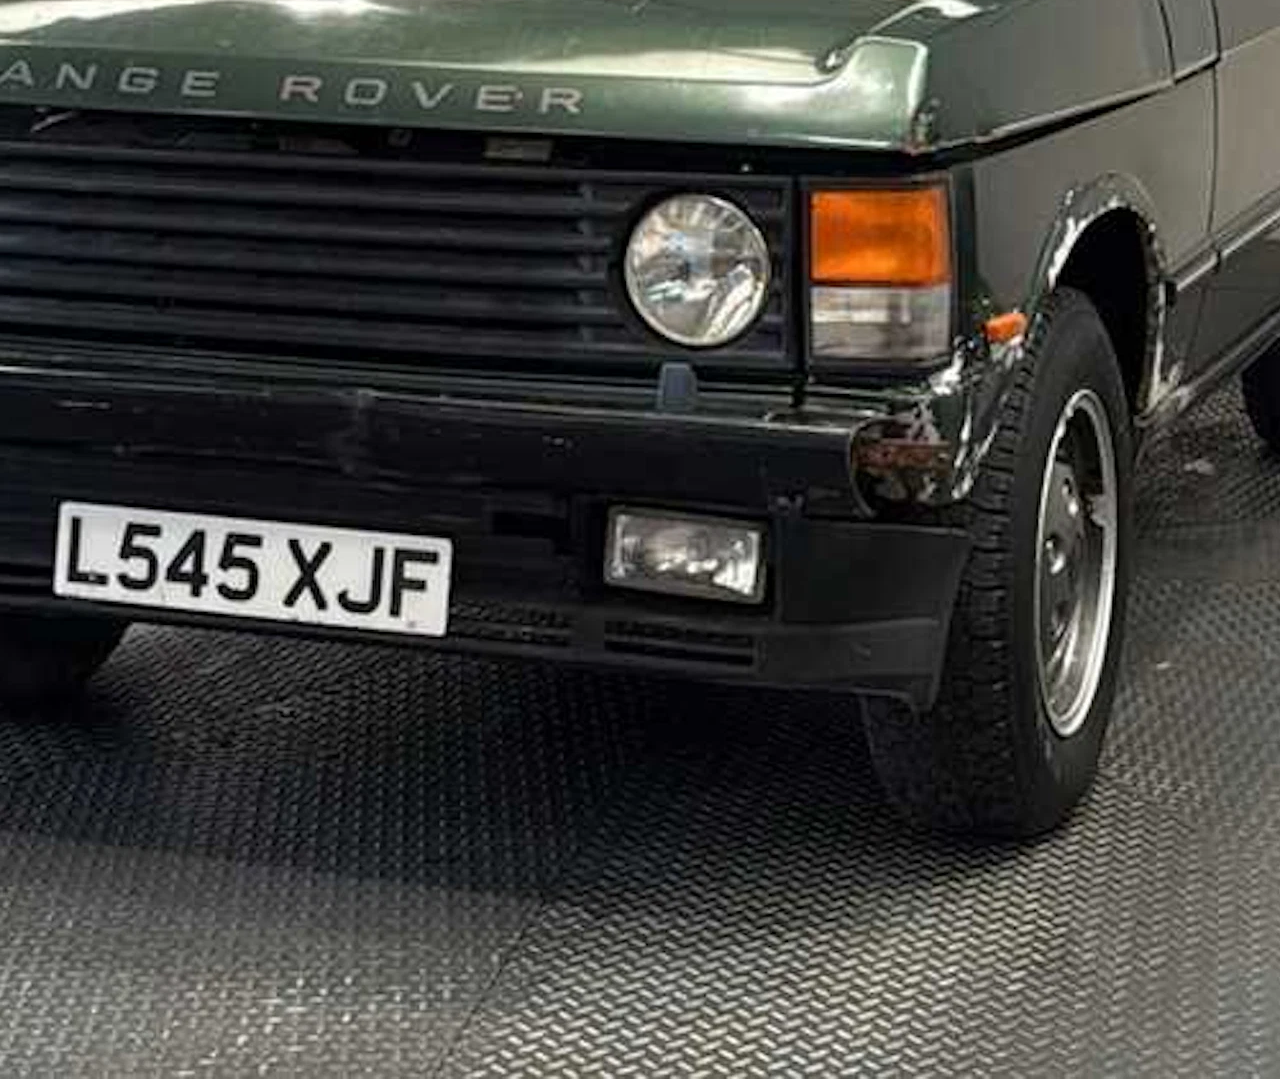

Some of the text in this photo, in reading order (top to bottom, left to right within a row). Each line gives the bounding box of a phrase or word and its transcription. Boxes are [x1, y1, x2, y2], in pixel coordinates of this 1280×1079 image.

[279, 76, 586, 115] ROVER
[66, 515, 440, 619] L545 XJF
